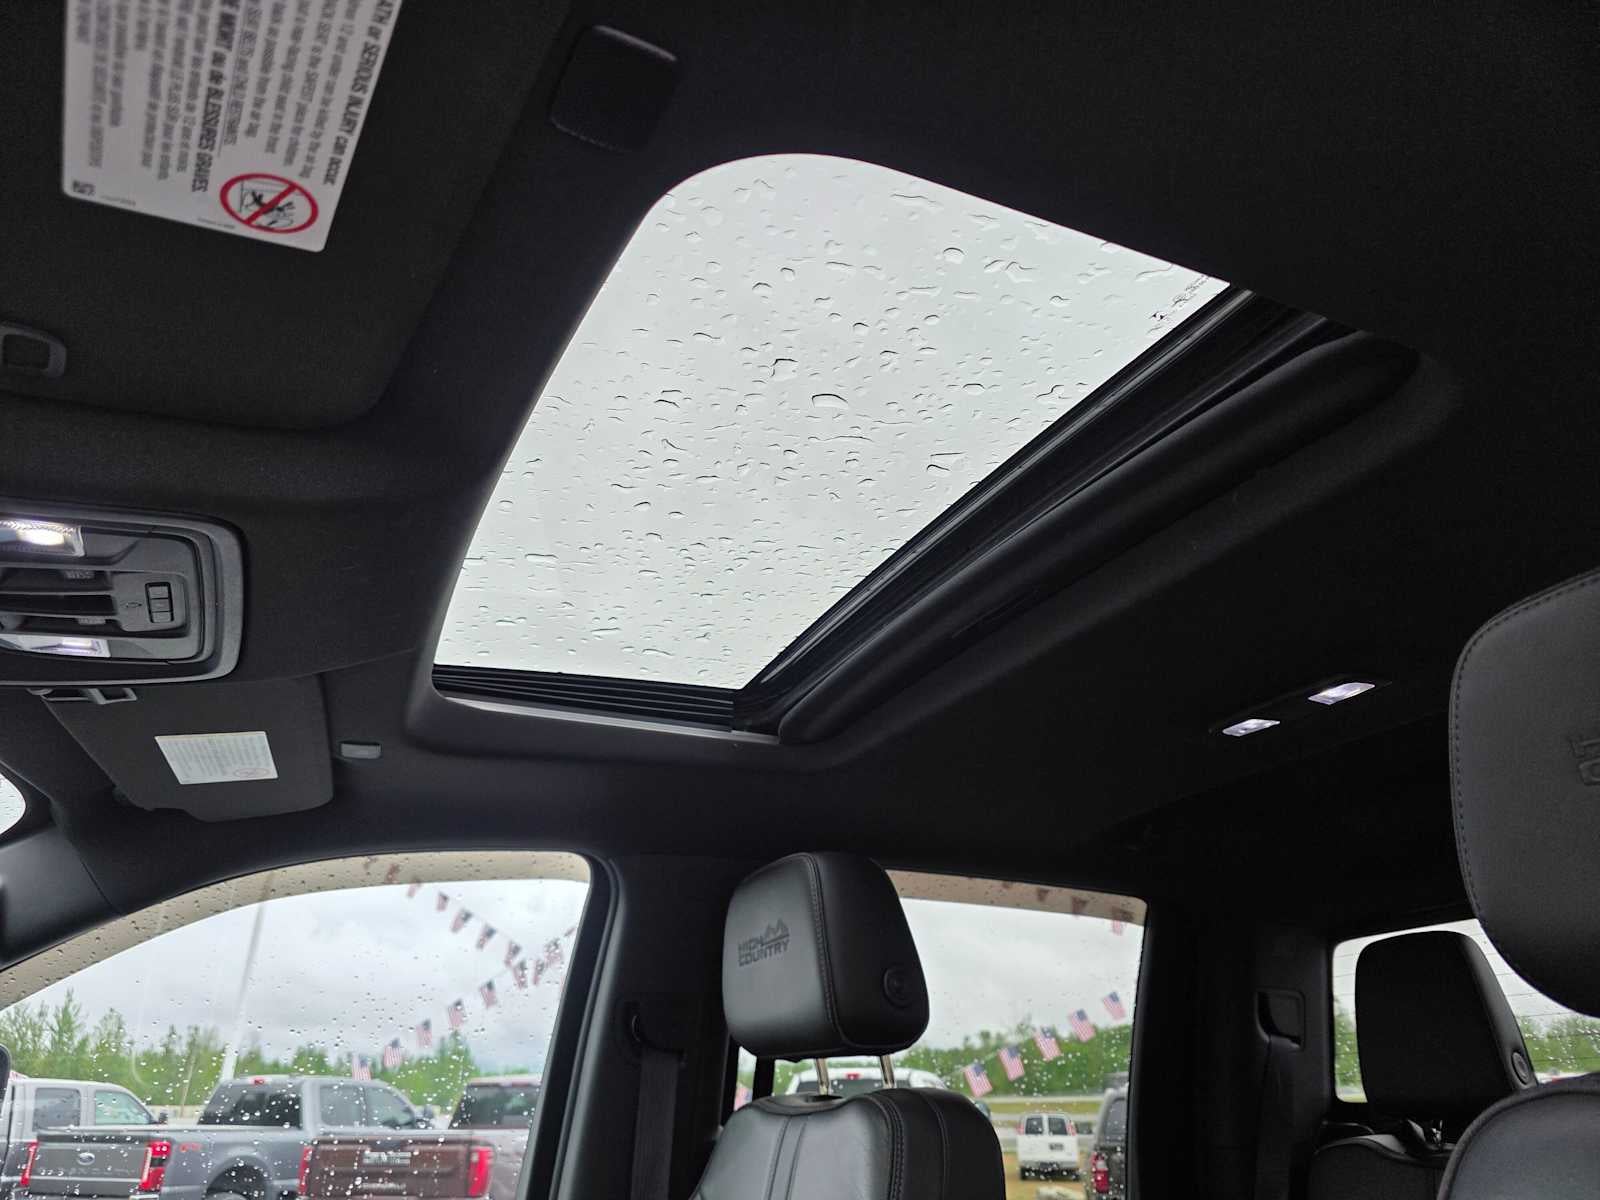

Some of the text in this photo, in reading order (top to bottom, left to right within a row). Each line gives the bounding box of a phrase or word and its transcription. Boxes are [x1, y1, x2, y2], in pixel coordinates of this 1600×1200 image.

[208, 69, 226, 85] de
[352, 41, 381, 94] SERIOUS
[198, 86, 224, 151] BLESSURES
[340, 94, 365, 136] INJURY
[333, 135, 348, 156] can
[738, 940, 790, 967] COUNTRY
